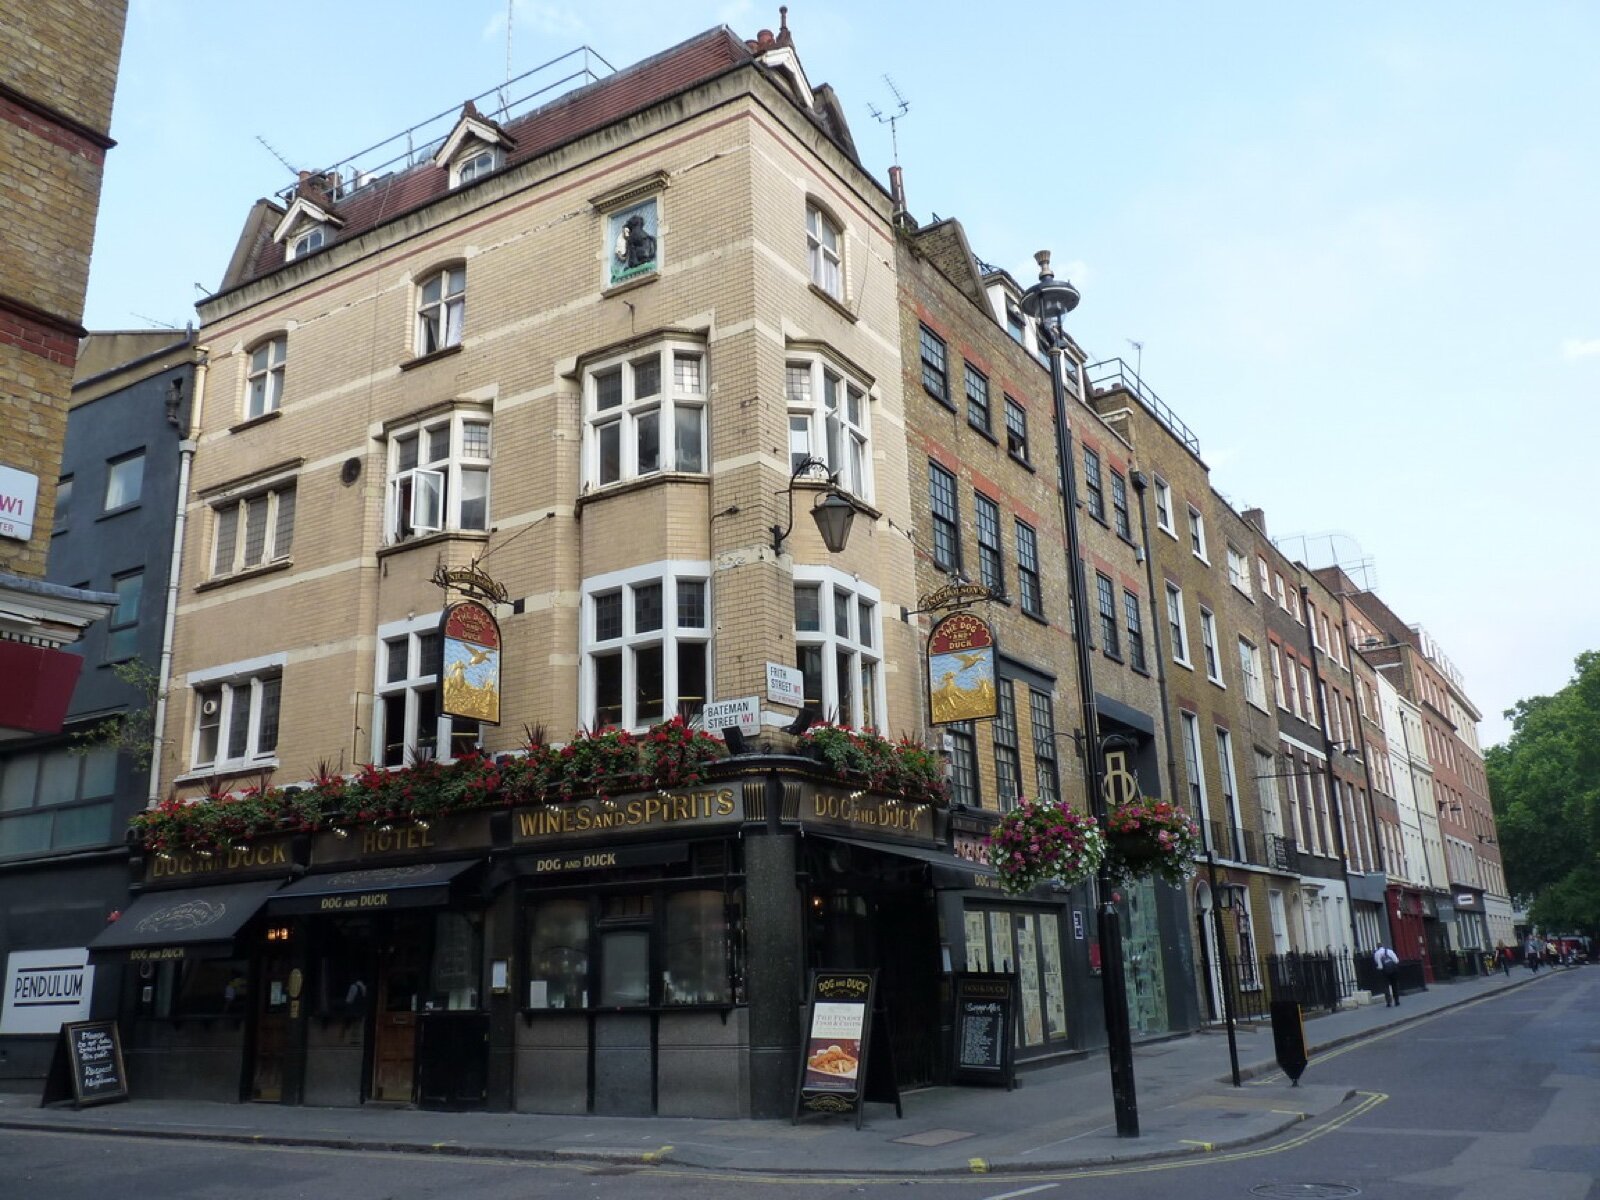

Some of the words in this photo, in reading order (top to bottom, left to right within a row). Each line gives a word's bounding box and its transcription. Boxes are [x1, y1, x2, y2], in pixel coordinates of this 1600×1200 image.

[942, 624, 958, 637] THE
[960, 621, 977, 633] DOG
[949, 640, 973, 649] DUCK
[770, 667, 787, 680] FRITH
[770, 678, 792, 693] STREET
[707, 701, 750, 718] BATEMAN
[708, 715, 739, 729] STREET
[741, 713, 754, 723] W1
[519, 805, 591, 837] WINES
[592, 811, 626, 829] AND
[627, 789, 736, 826] SPIRITS
[815, 793, 851, 821] DOG
[878, 803, 919, 832] DUCK
[363, 826, 435, 854] HOTEL
[227, 842, 286, 869] DUCK
[536, 858, 562, 872] DOG
[564, 860, 582, 870] AND
[583, 853, 616, 868] DUCK
[321, 898, 342, 909] DOG
[360, 893, 389, 907] DUCK
[130, 949, 147, 961] DOG
[161, 946, 185, 958] DUCK
[14, 974, 84, 999] PENDULUM
[818, 978, 835, 993] DOG
[846, 977, 869, 993] DUCK
